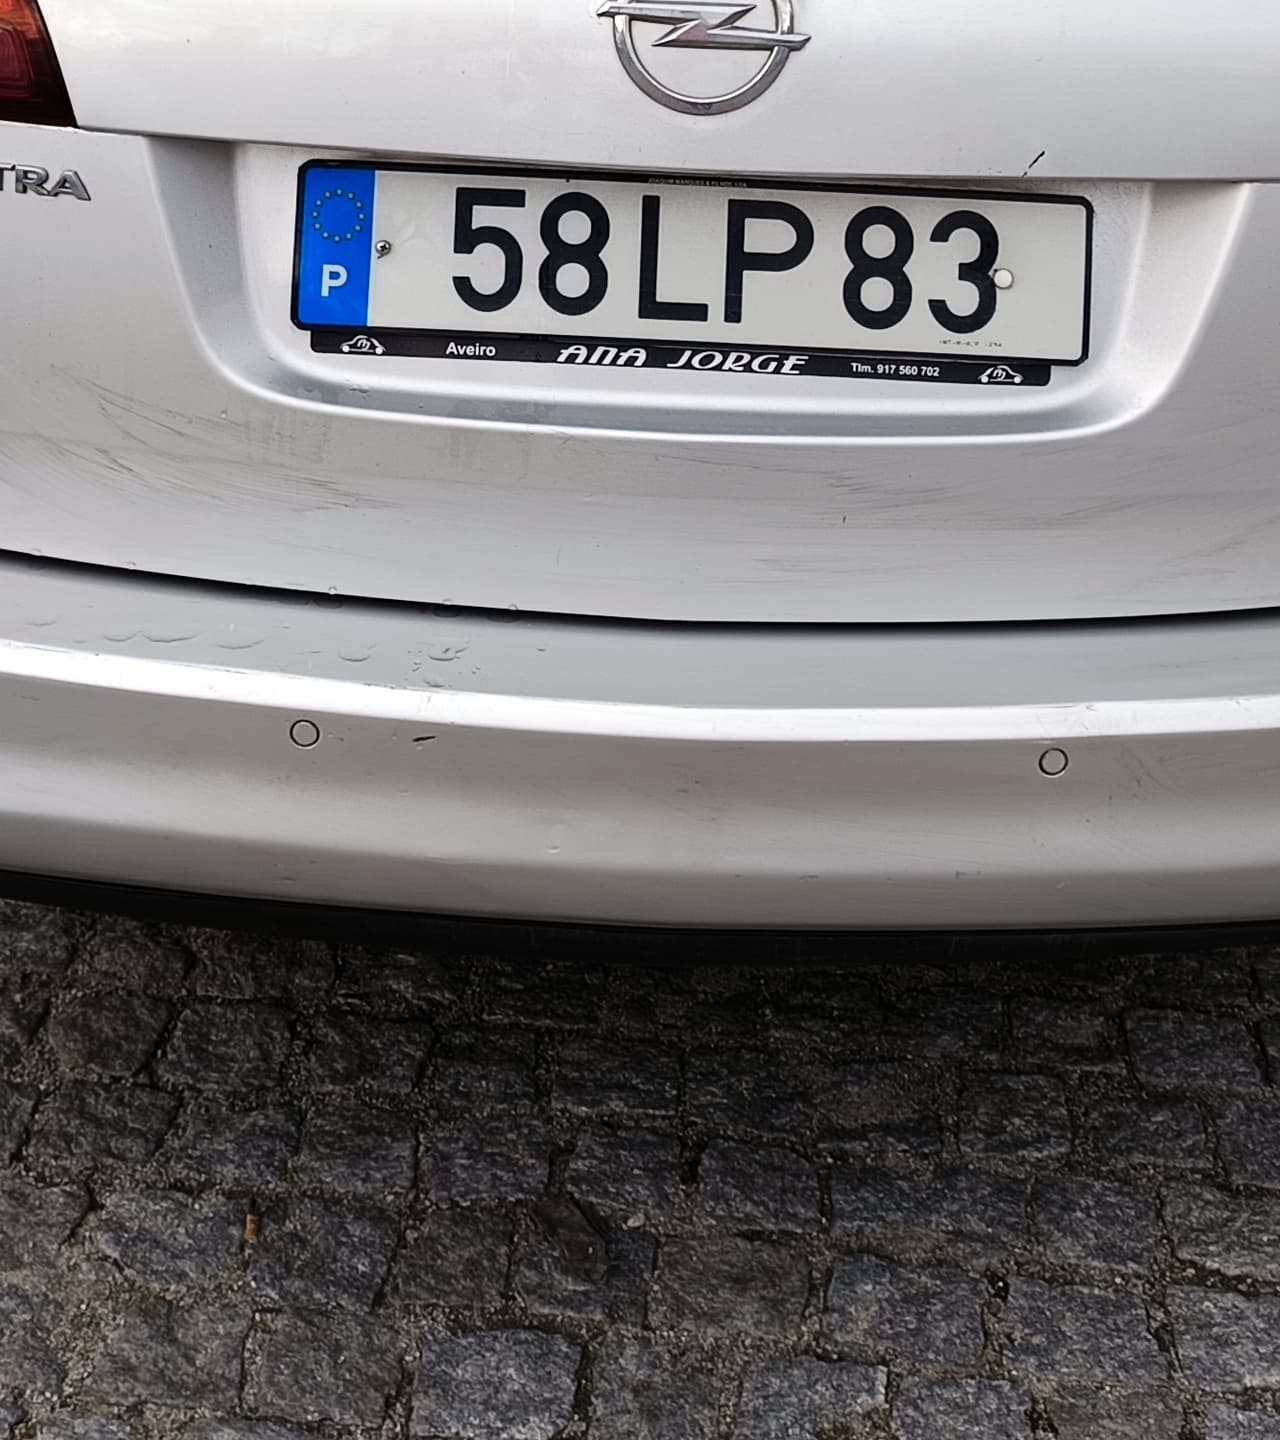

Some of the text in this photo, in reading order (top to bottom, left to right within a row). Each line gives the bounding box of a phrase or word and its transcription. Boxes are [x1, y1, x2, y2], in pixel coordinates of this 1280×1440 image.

[450, 186, 1000, 334] 58 LP 83
[320, 264, 348, 298] P
[445, 341, 940, 377] Aveiro ANA JORGE Tlm. 917 560 702
